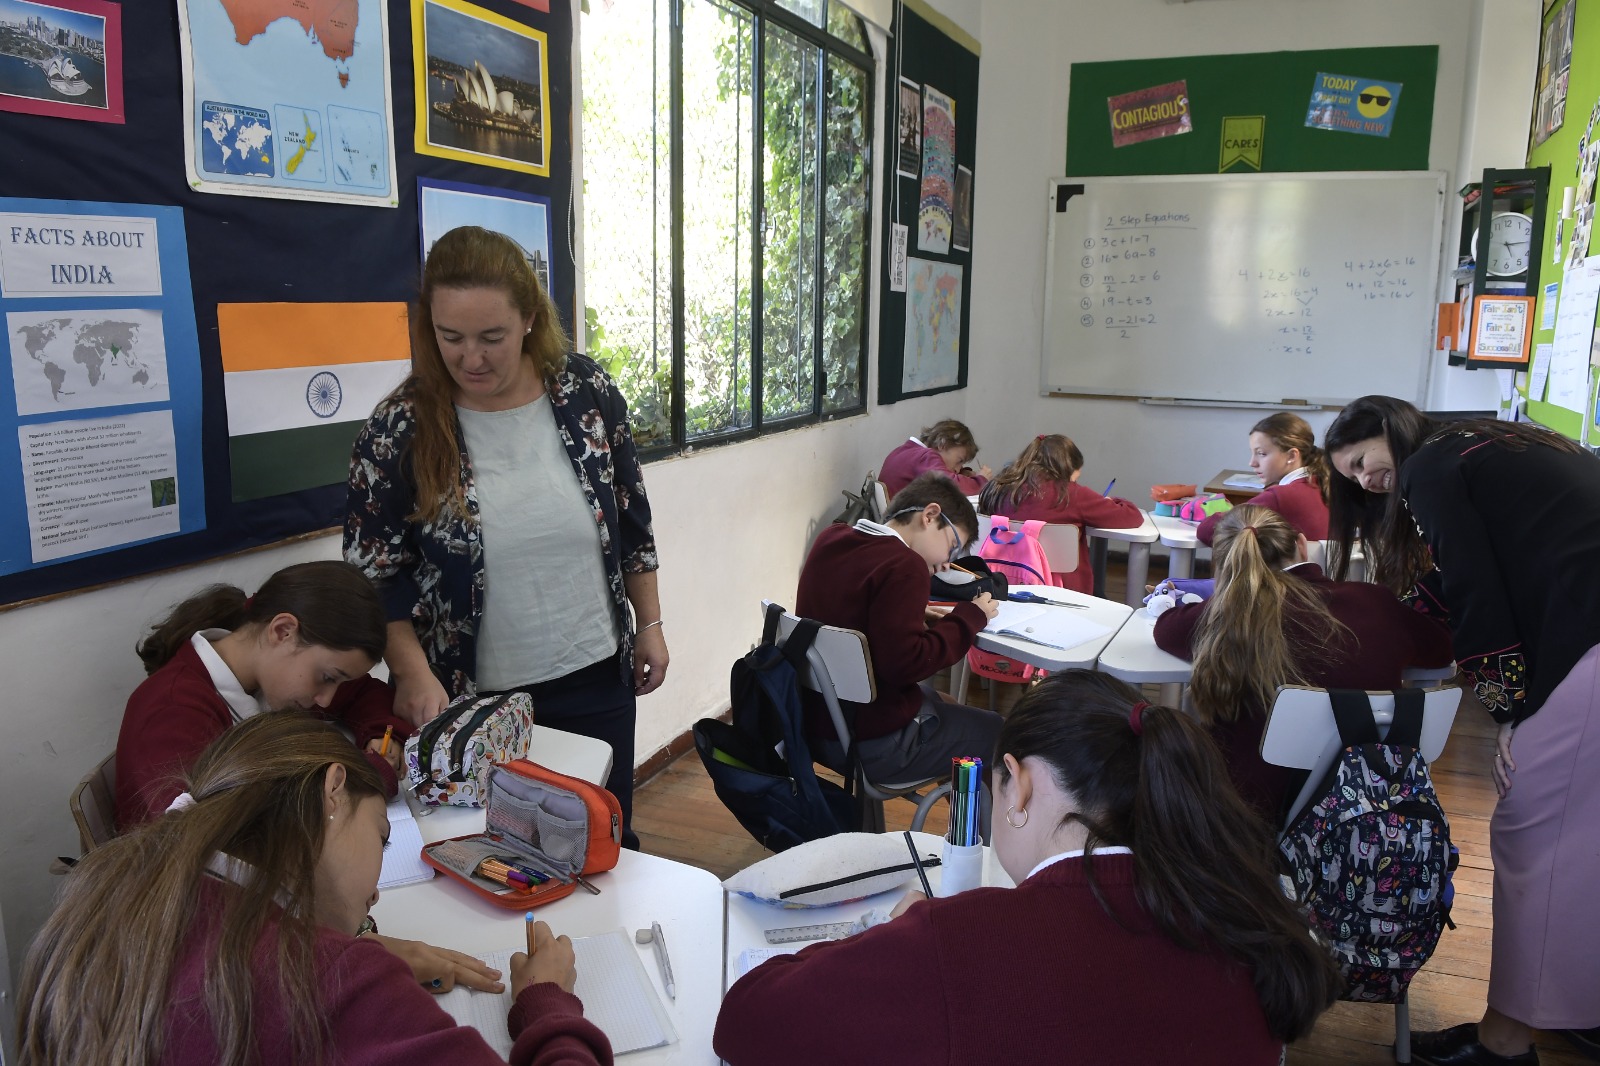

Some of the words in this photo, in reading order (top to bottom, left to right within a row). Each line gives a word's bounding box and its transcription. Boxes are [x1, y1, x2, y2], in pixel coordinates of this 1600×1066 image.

[1322, 76, 1357, 91] TODAY
[1113, 95, 1186, 129] CONTAGIOUS
[1364, 122, 1384, 132] NEW
[1224, 138, 1258, 149] CARES
[1107, 217, 1113, 226] 2
[1120, 216, 1141, 227] Step
[1145, 213, 1190, 226] Equations
[11, 227, 74, 246] FACTS
[82, 230, 144, 248] ABOUT
[51, 265, 114, 284] INDIA
[1238, 269, 1248, 282] 4
[1484, 304, 1500, 313] Fair
[1503, 304, 1523, 314] Isn't
[1486, 322, 1502, 331] Fair
[1120, 330, 1130, 338] 2
